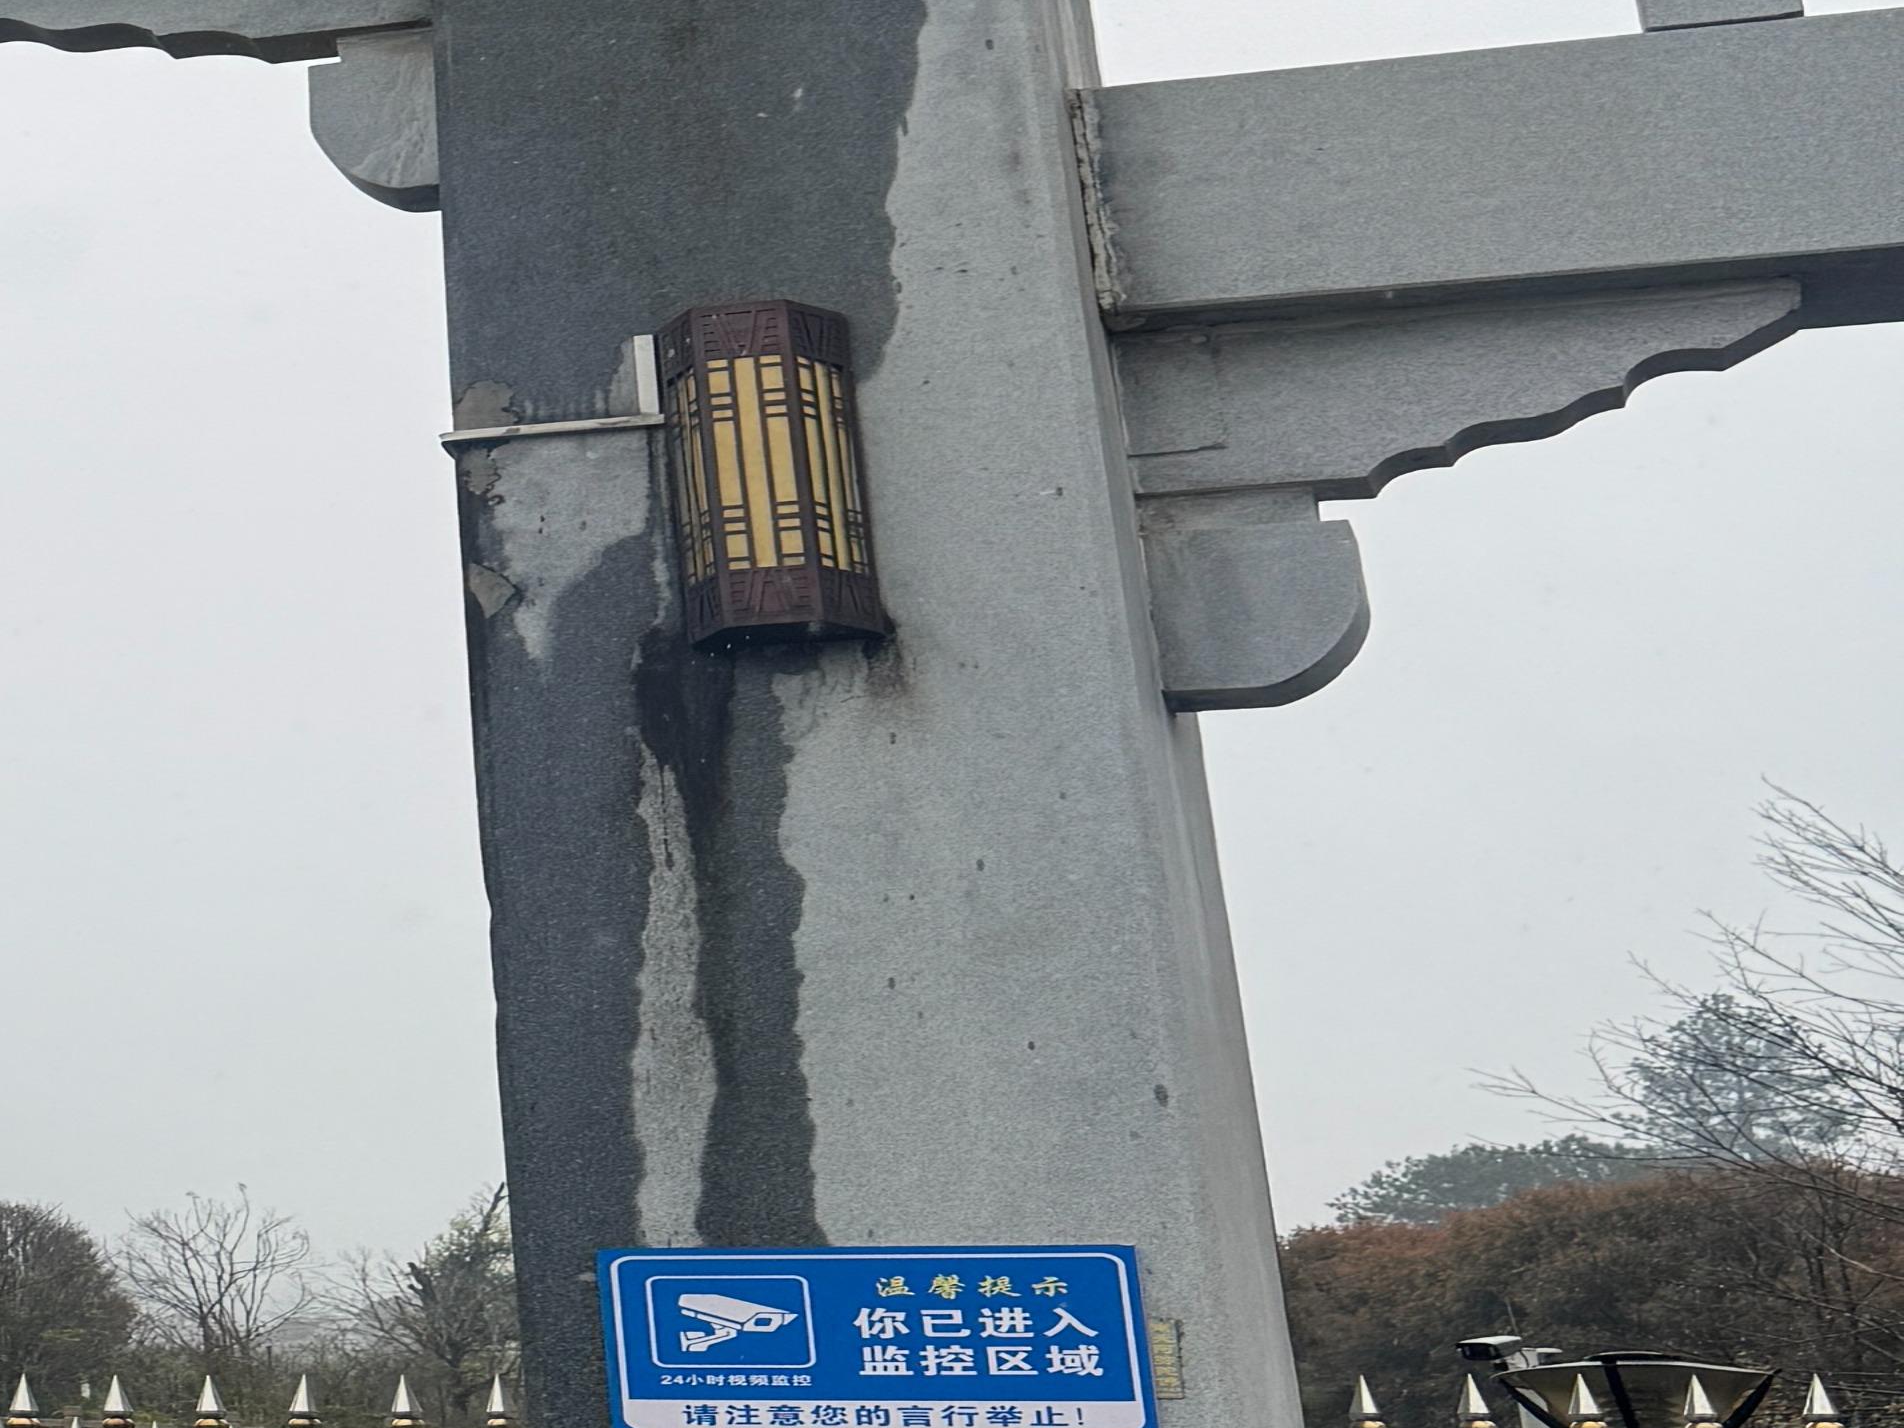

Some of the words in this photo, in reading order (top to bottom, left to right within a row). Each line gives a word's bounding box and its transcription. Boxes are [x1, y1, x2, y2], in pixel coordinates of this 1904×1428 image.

[875, 1274, 1070, 1300] 温馨提示
[852, 1307, 1100, 1339] 你已进入
[858, 1344, 1104, 1377] 监控区域
[659, 1373, 813, 1387] 24小时视频监控
